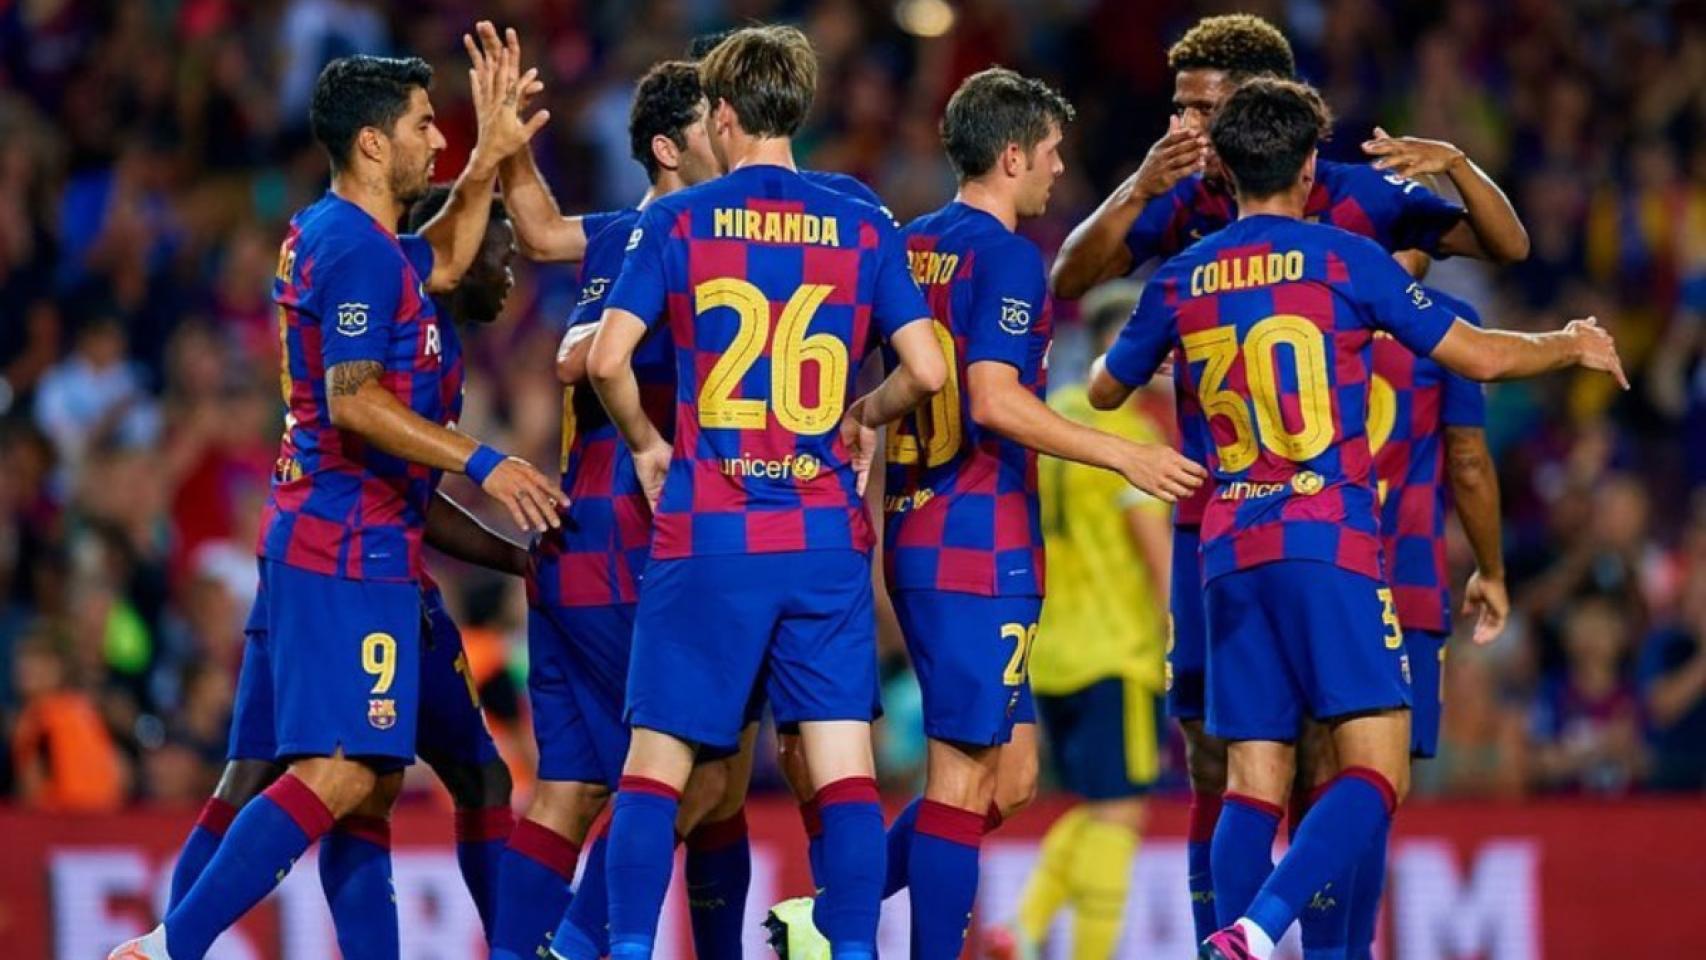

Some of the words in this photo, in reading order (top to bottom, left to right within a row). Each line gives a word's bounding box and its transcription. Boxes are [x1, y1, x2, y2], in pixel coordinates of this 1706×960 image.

[714, 208, 840, 247] MIRANDA
[1191, 250, 1305, 297] COLLADO
[695, 277, 848, 435] 26
[1181, 313, 1336, 474] 30
[720, 453, 793, 479] unicef
[361, 632, 398, 695] 9
